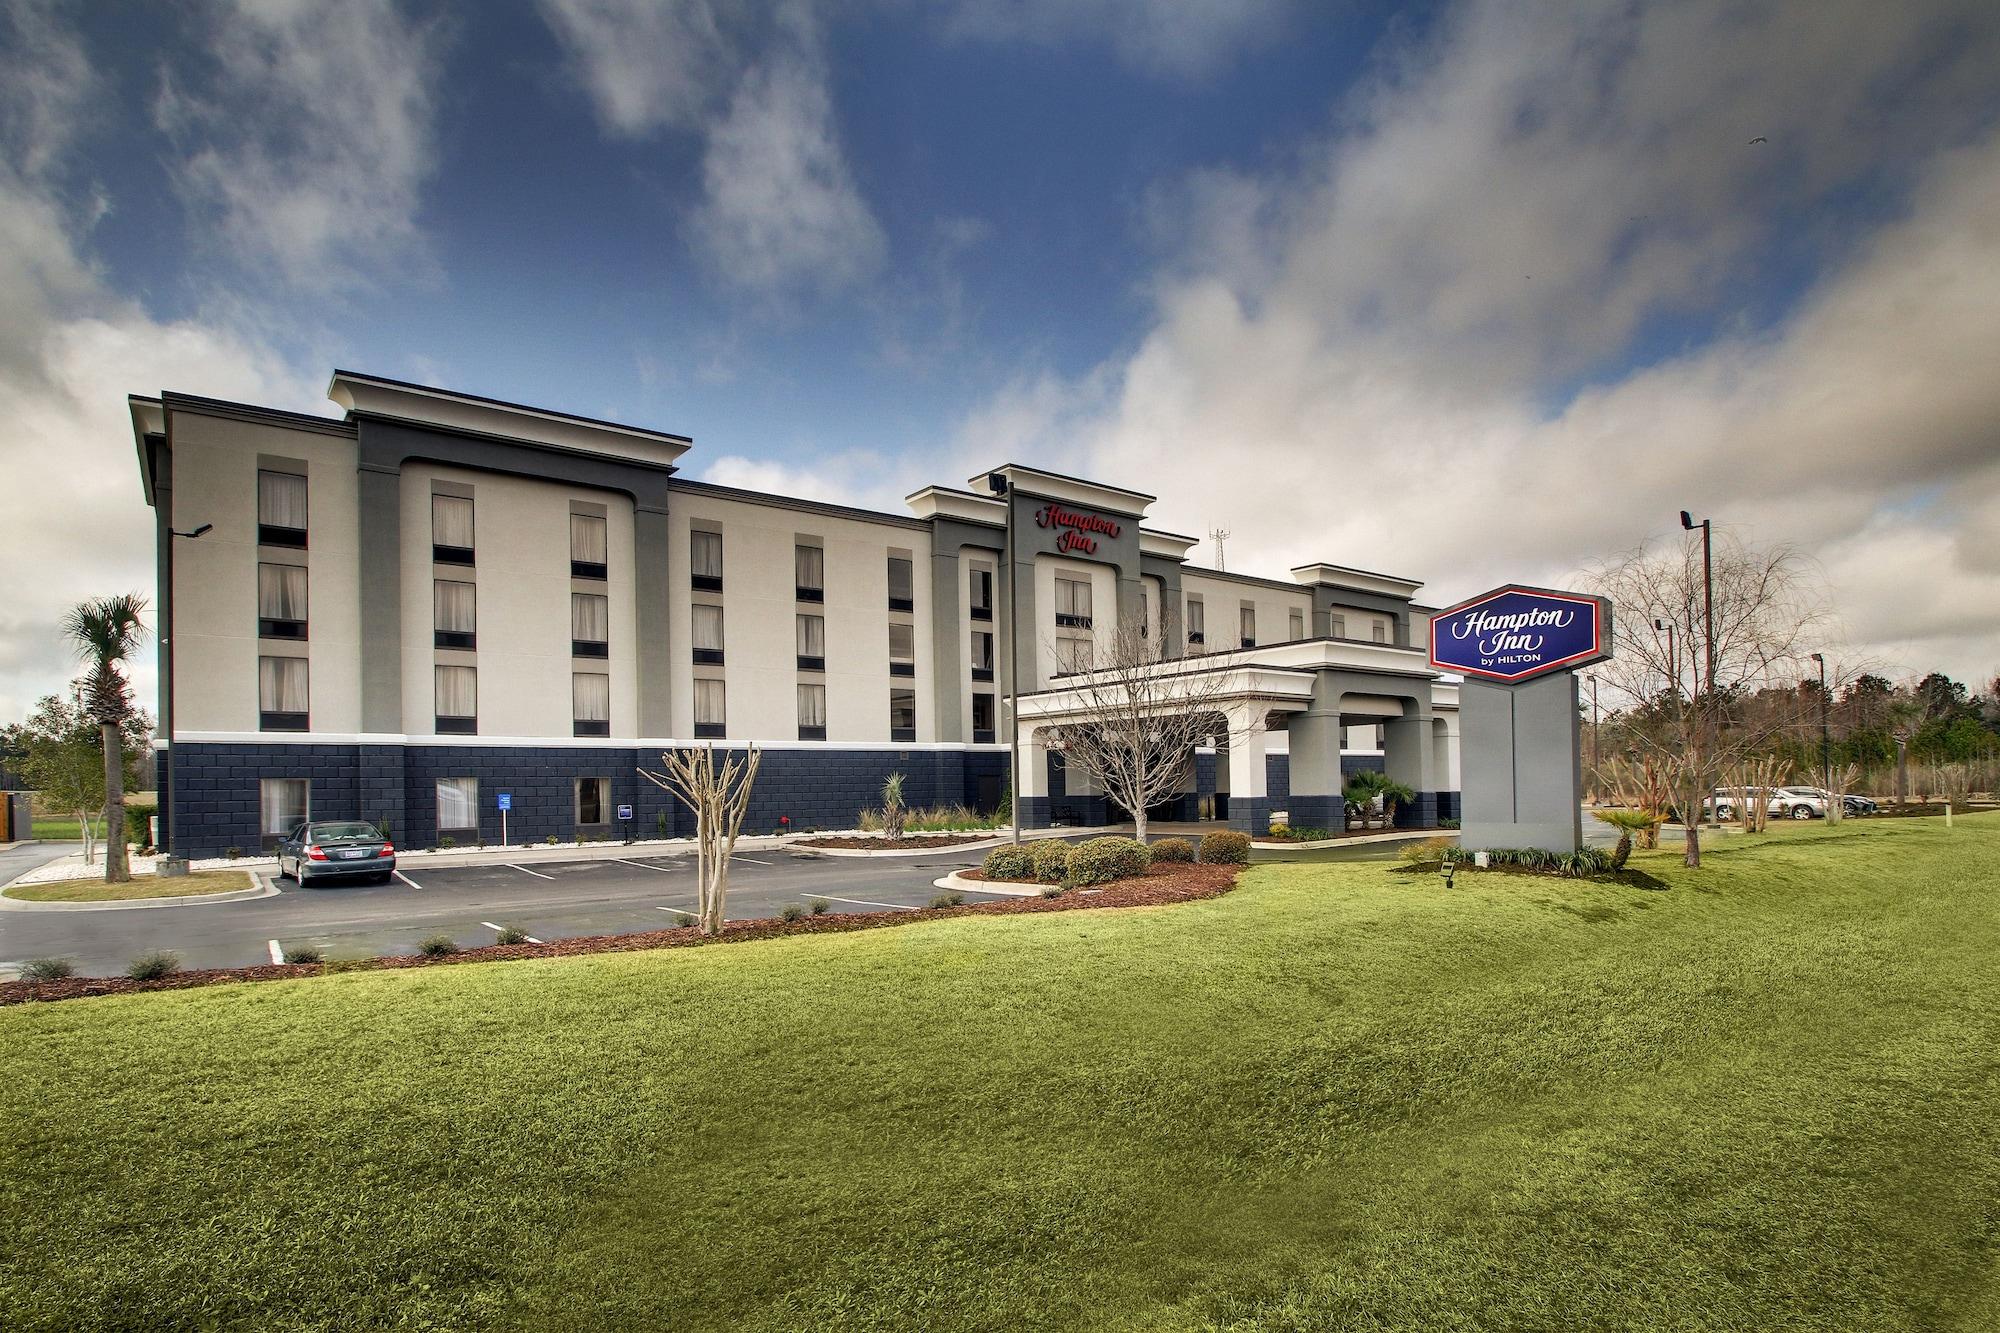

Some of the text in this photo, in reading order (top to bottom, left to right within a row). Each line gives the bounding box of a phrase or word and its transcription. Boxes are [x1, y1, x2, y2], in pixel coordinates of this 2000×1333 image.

[1035, 502, 1121, 538] Hampton
[1056, 529, 1097, 554] Inn
[1451, 607, 1574, 639] Hampton
[1479, 630, 1543, 656] Inn
[1481, 653, 1541, 667] by HILTON
